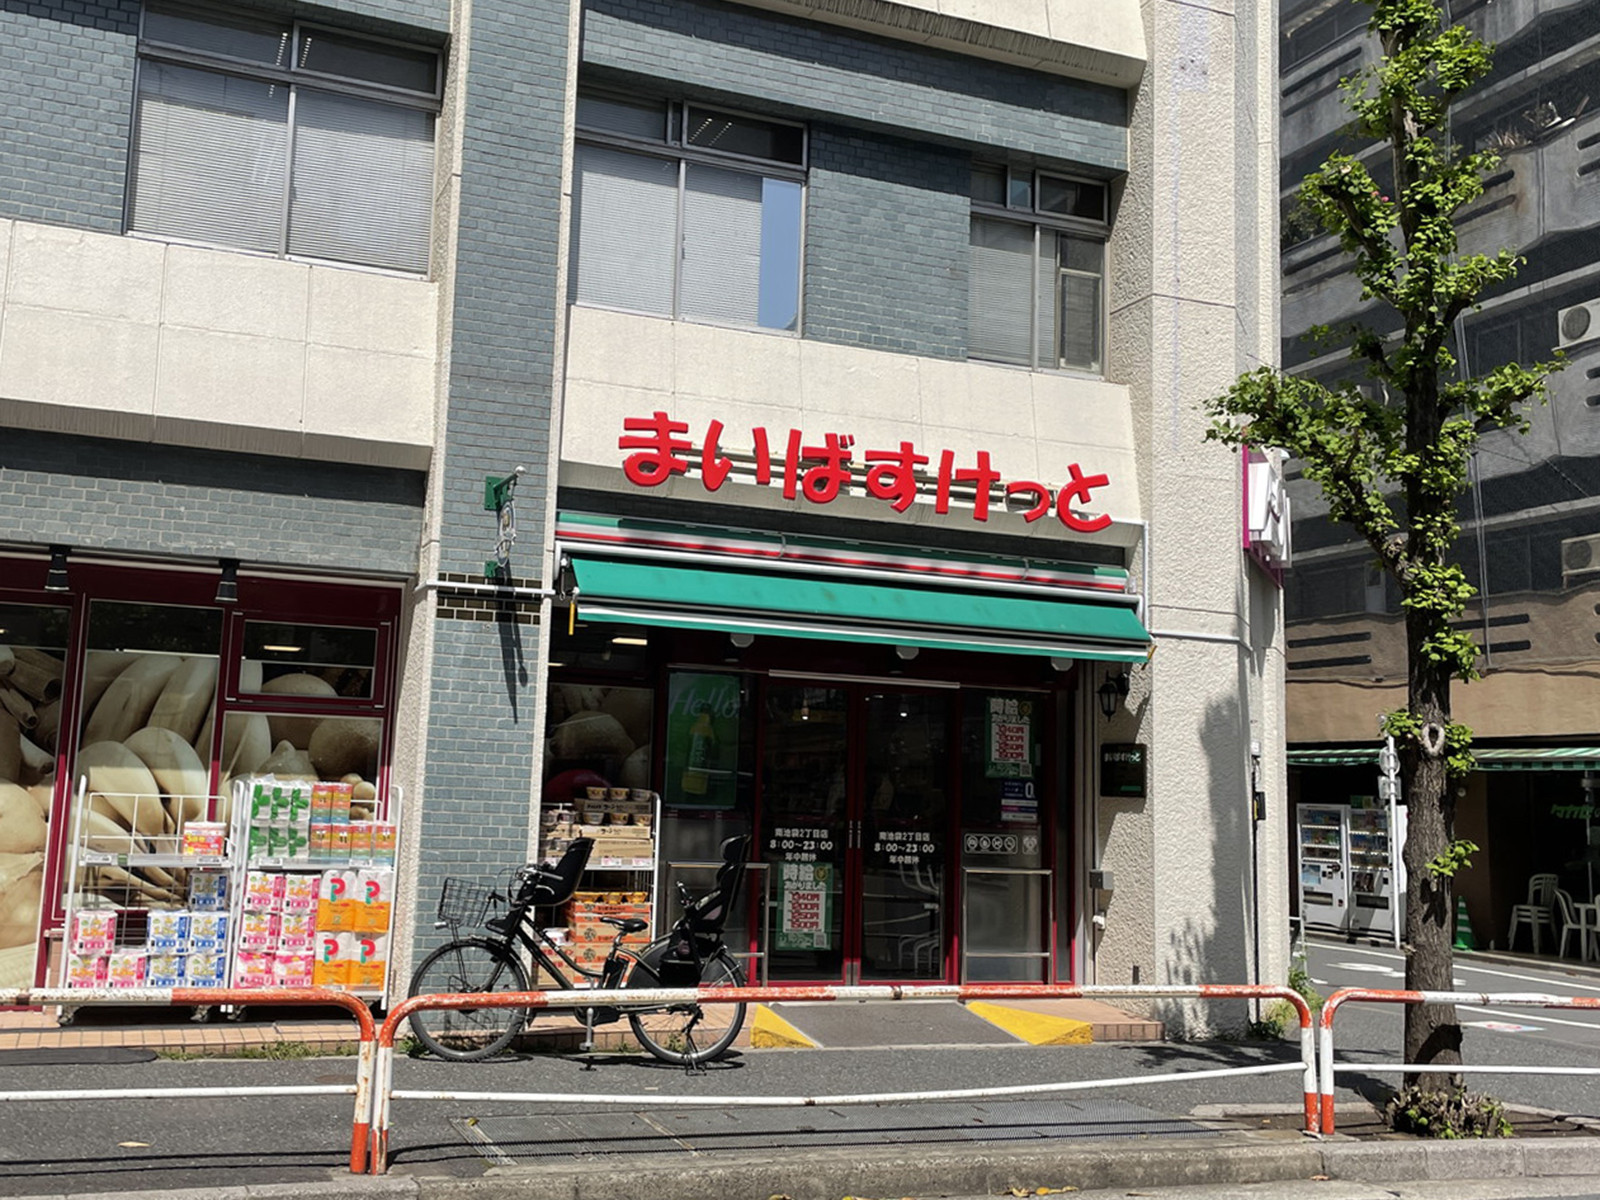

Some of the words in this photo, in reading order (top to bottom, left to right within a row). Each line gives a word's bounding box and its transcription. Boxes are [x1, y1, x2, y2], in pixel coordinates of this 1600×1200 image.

[618, 411, 1113, 533] まいばすけっと
[774, 827, 829, 839] 南池袋2丁目店
[878, 831, 931, 842] 南池袋2丁目店
[785, 852, 817, 862] 年中無休
[888, 854, 920, 864] 年中無休
[783, 863, 815, 881] 時給
